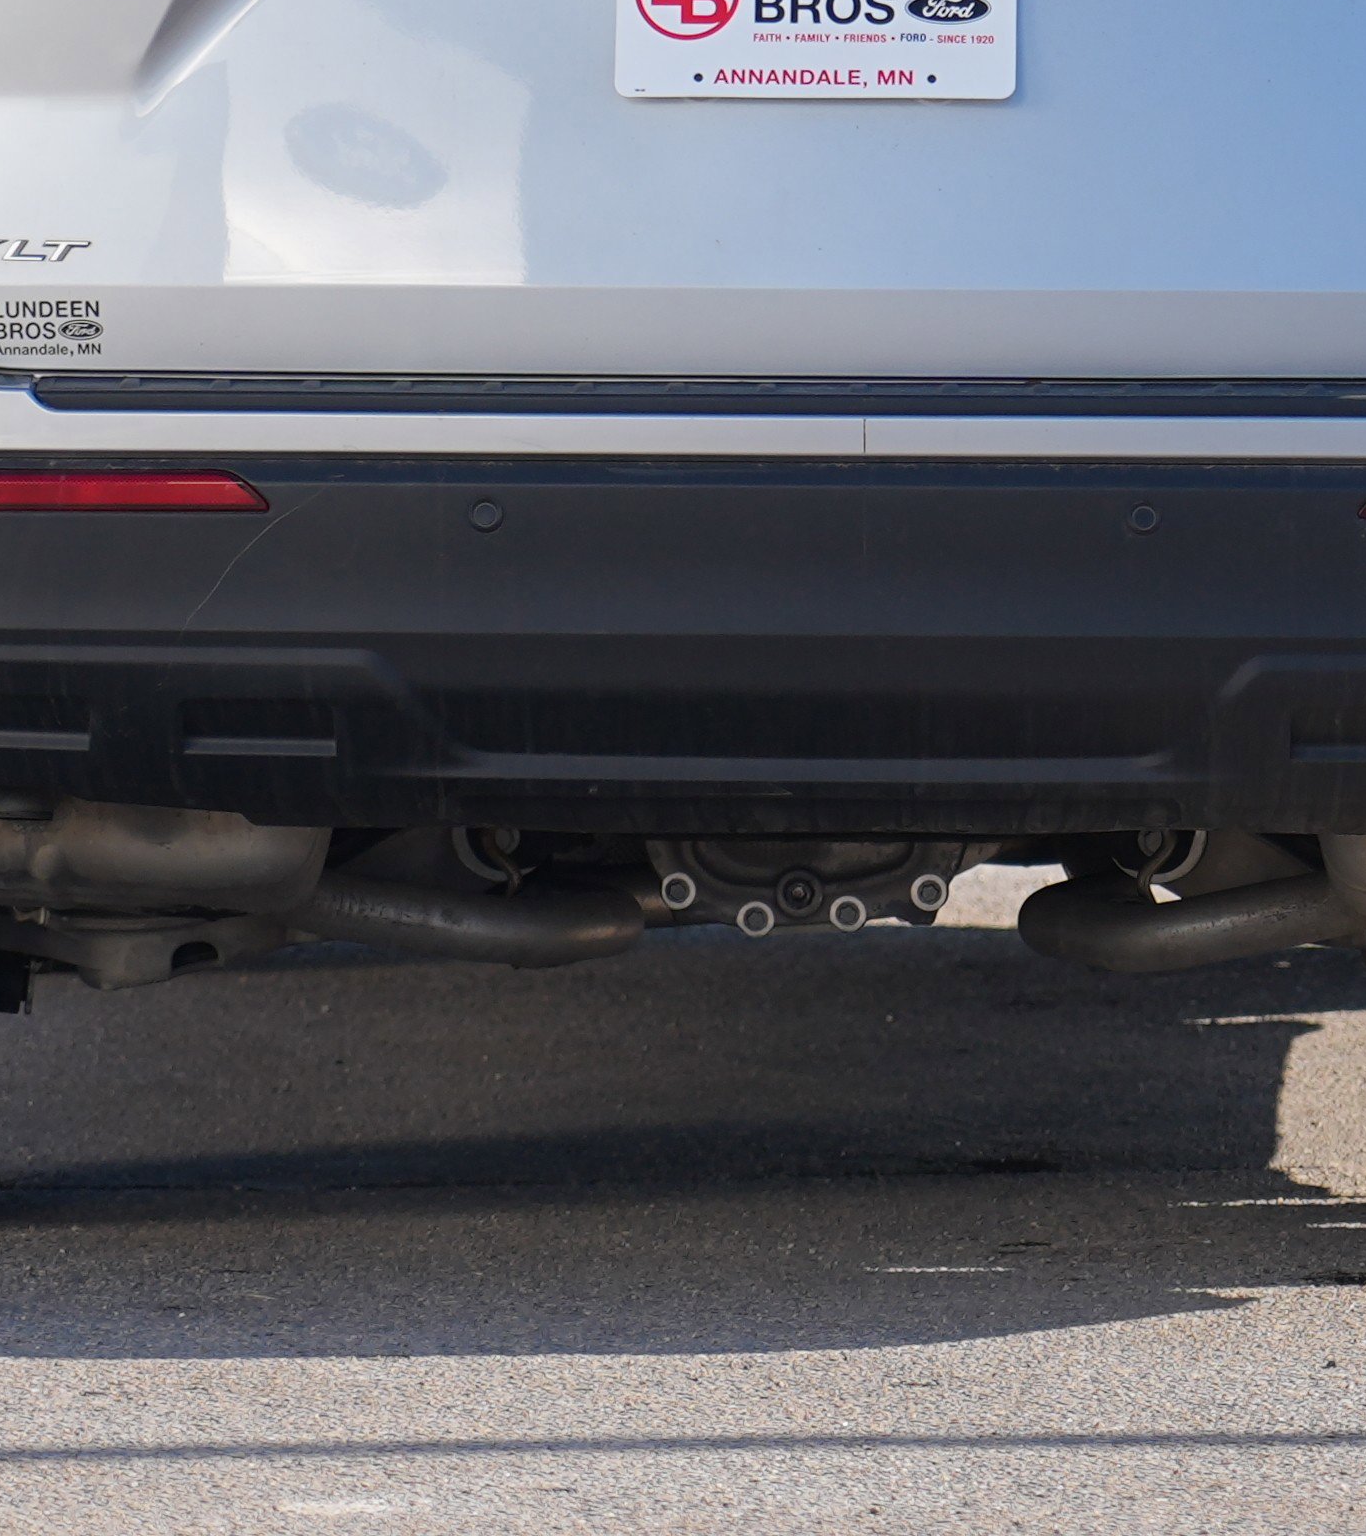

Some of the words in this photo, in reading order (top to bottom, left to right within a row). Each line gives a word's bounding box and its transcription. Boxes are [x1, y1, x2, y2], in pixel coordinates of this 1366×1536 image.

[753, 33, 782, 43] FAITH
[795, 33, 832, 43] FAMILY
[843, 33, 887, 43] FRIENDS
[900, 33, 927, 42] FORD
[937, 35, 967, 44] SINCE
[971, 35, 995, 44] 1920
[713, 68, 869, 88] ANNANDALE,
[877, 69, 915, 86] MN
[77, 343, 102, 355] MN
